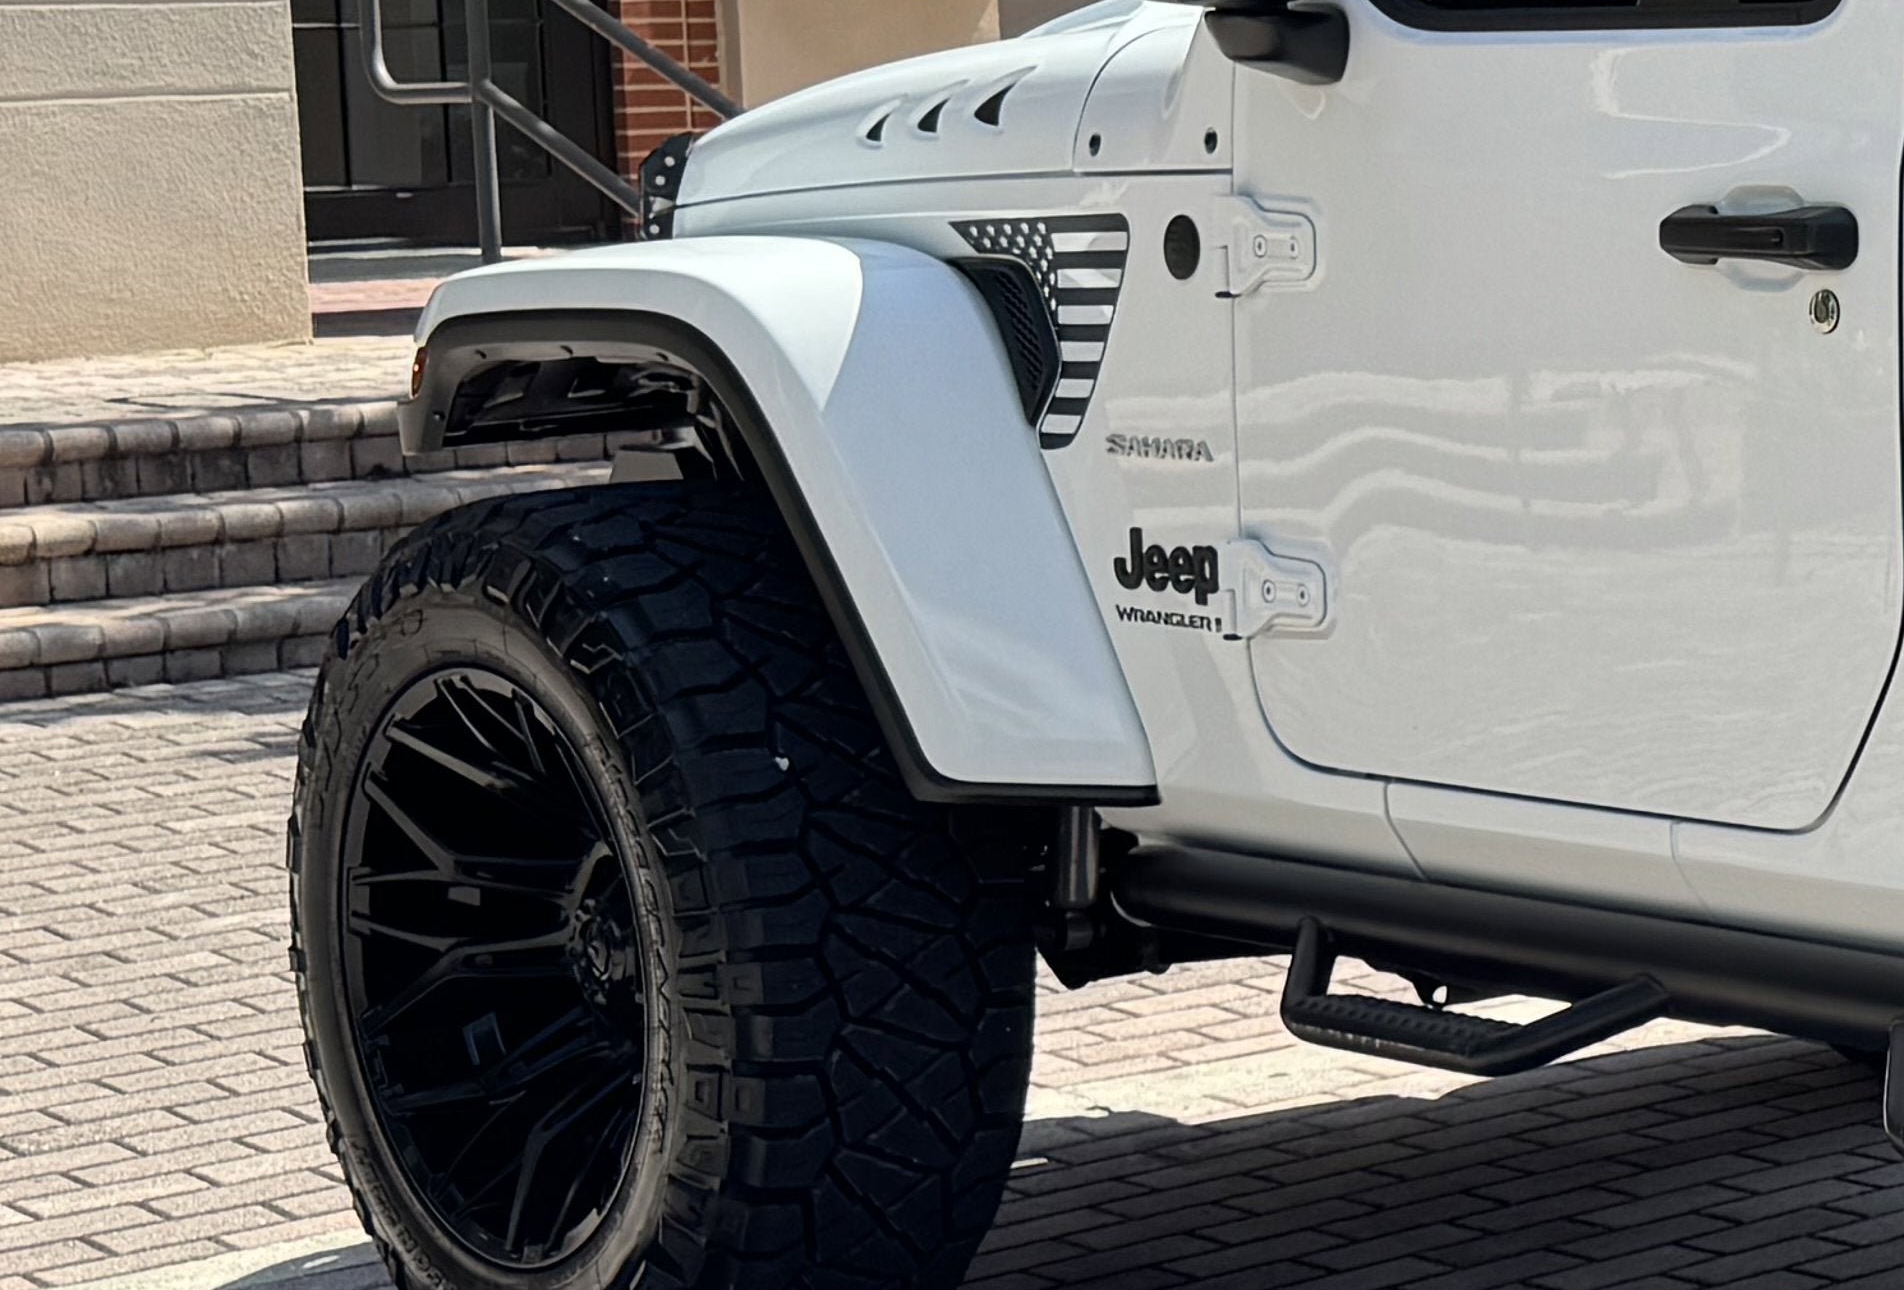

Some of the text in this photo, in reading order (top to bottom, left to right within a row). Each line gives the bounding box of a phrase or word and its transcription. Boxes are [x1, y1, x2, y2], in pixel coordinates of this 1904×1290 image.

[1105, 433, 1214, 462] SAHARA
[1113, 526, 1219, 606] Jeep
[1115, 604, 1212, 632] WRANGLER
